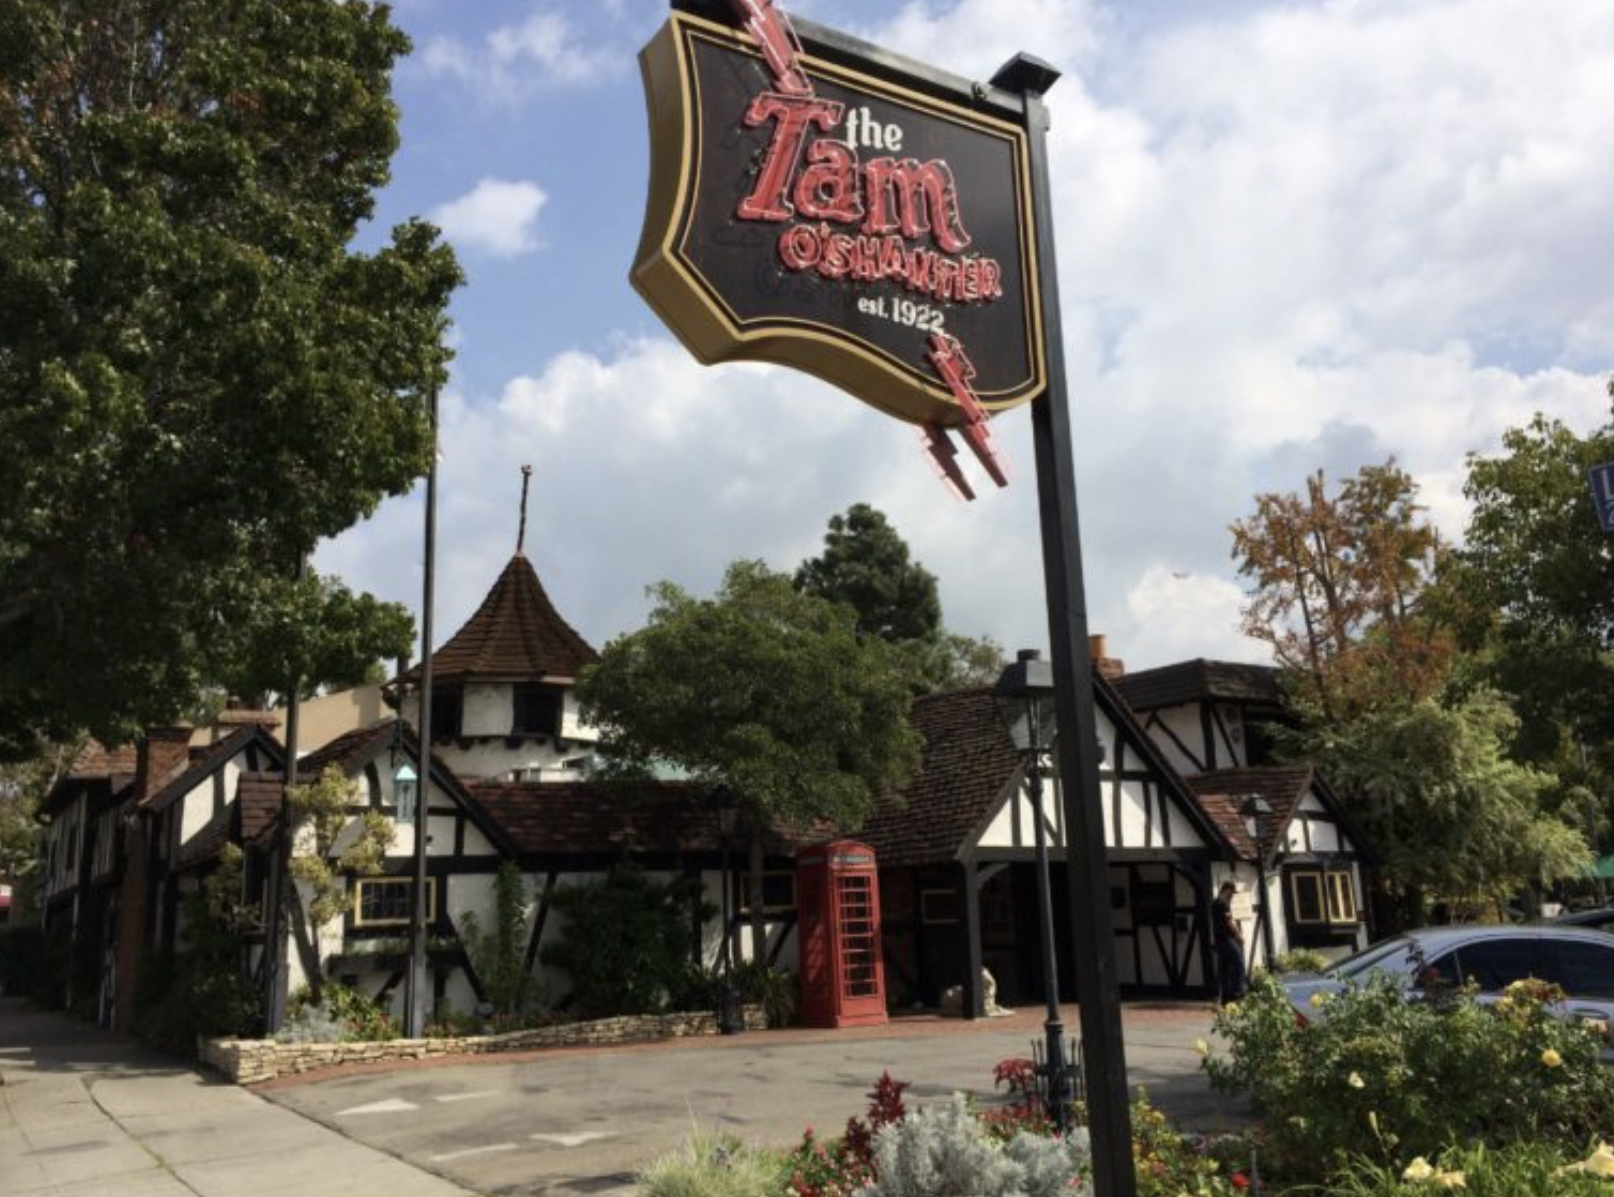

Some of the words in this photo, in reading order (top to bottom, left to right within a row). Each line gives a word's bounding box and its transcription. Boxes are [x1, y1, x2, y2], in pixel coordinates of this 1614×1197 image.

[846, 107, 903, 150] the
[737, 92, 971, 253] Tam
[893, 297, 945, 333] 1922
